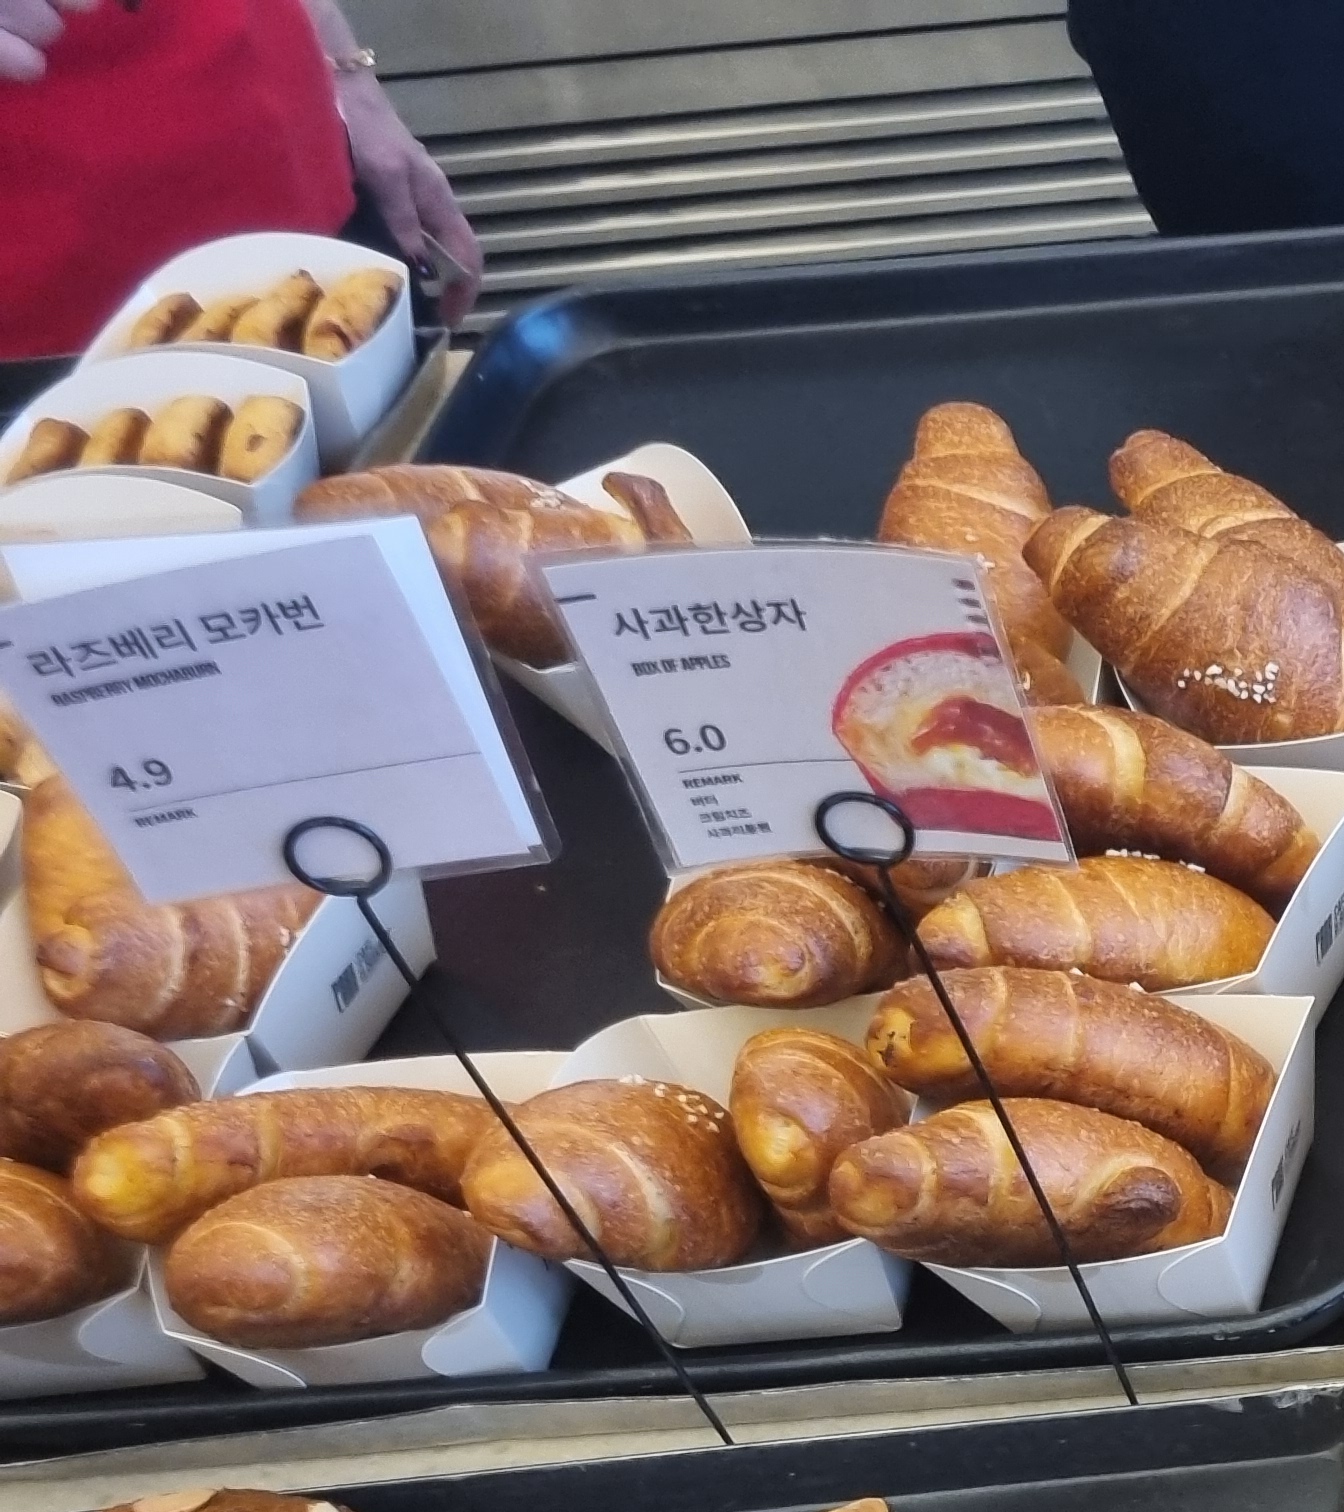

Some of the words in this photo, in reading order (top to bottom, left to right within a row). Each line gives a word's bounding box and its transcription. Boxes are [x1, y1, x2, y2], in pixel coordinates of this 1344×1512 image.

[615, 598, 808, 641] 사과한상자
[26, 618, 198, 679] 라즈베리
[197, 594, 325, 645] 모카번
[631, 660, 661, 677] BOX
[661, 658, 679, 673] OF
[680, 654, 731, 672] APPLES
[662, 723, 728, 756] 6.0
[109, 758, 174, 794] 4.9
[681, 773, 744, 790] REMARK
[134, 807, 200, 829] REMARK
